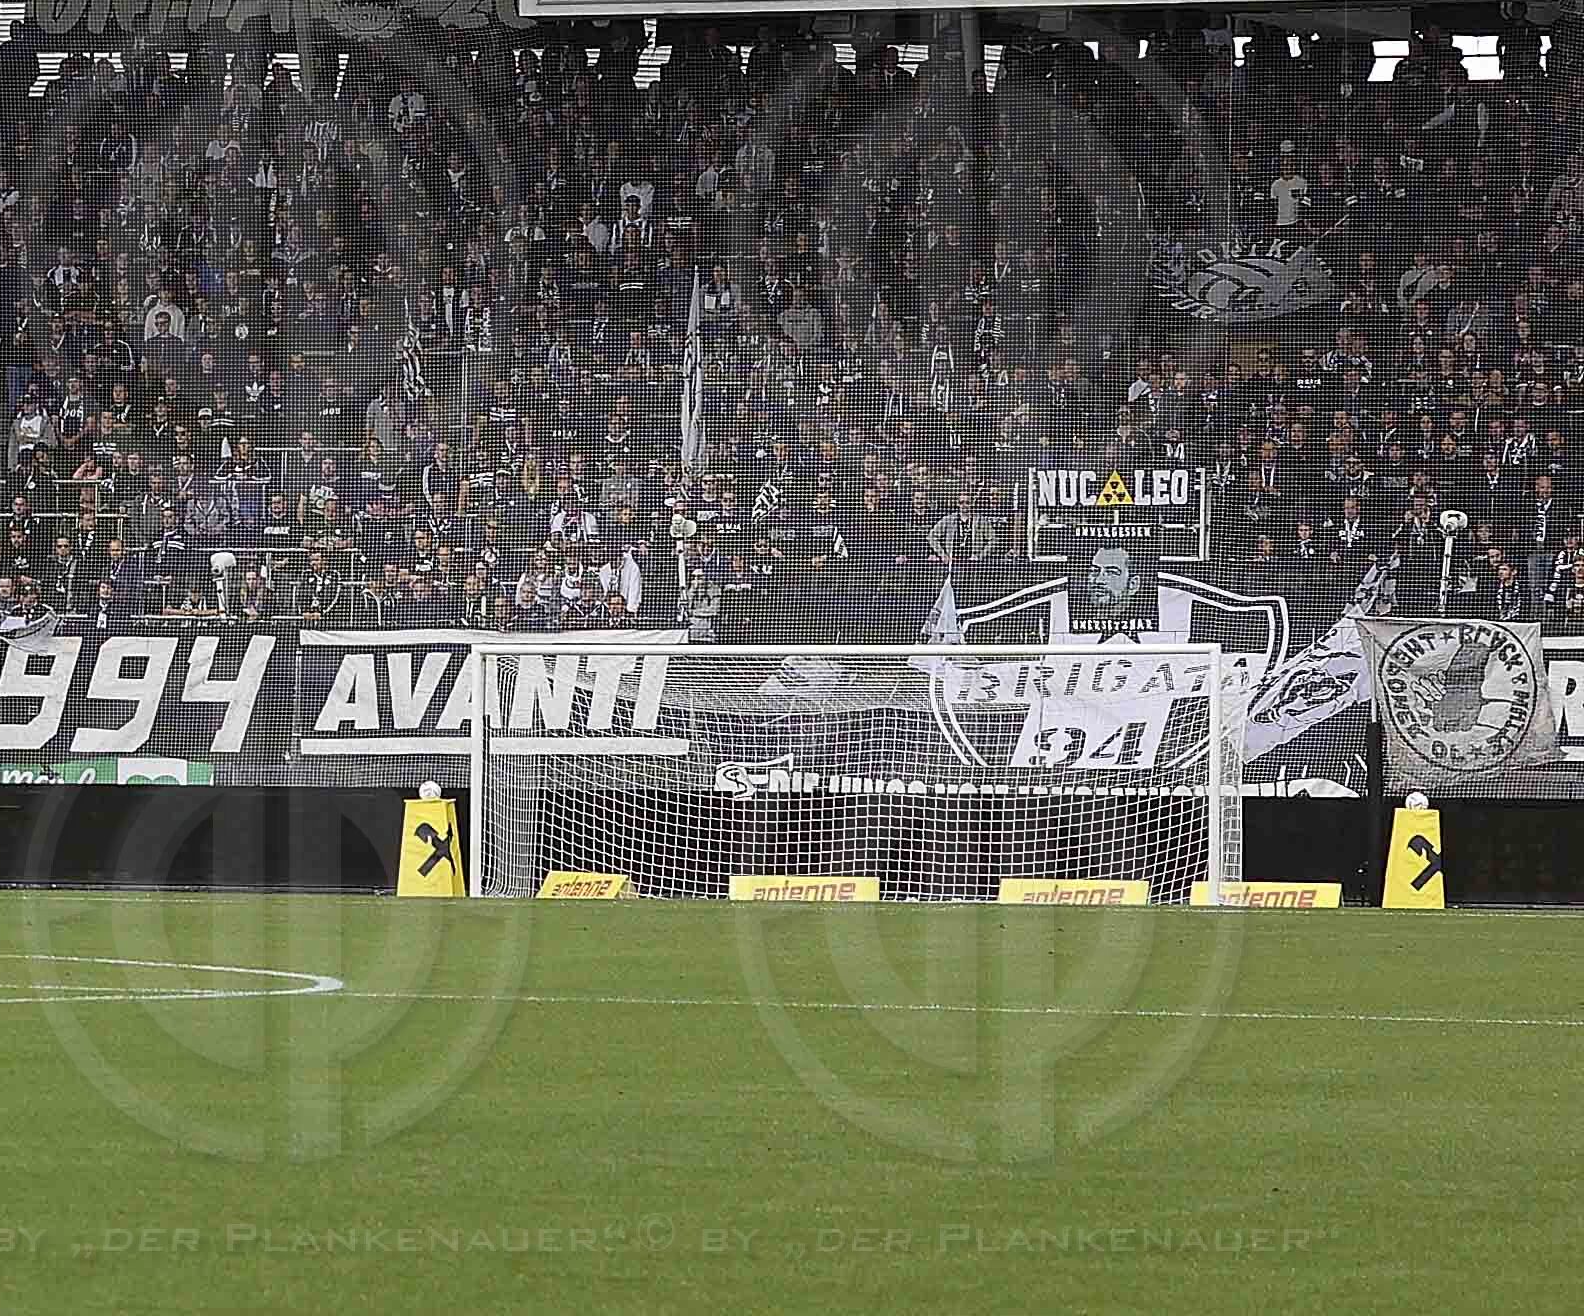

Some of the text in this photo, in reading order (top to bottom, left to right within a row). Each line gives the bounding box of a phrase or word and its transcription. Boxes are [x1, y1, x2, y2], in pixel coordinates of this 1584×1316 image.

[314, 652, 672, 732] AVANTI
[551, 875, 613, 897] antenne
[751, 880, 856, 901] antenne
[1022, 884, 1125, 905] antenne
